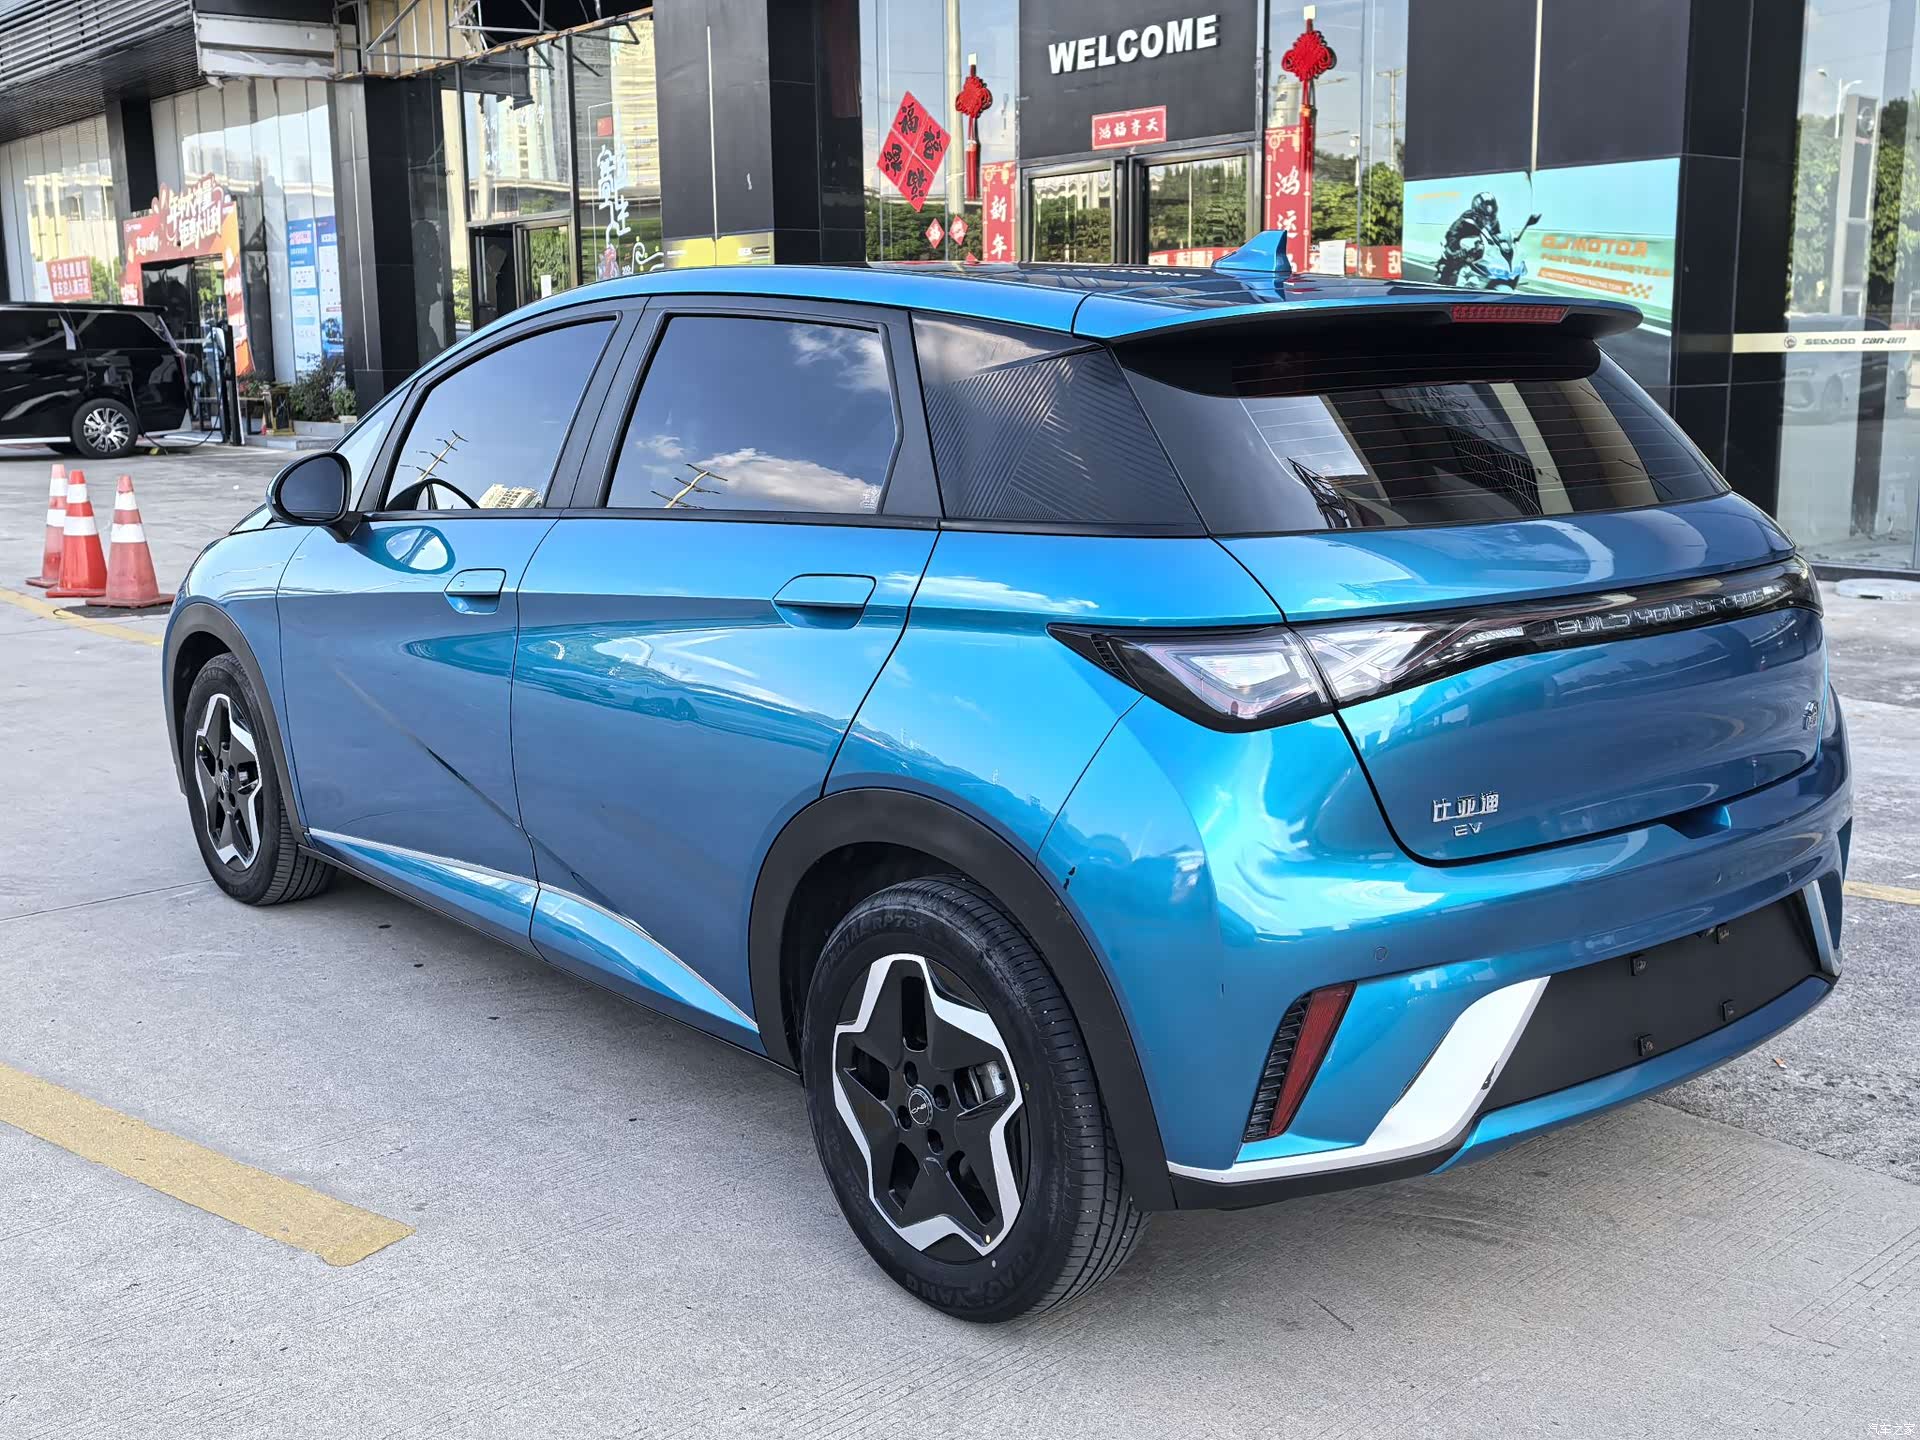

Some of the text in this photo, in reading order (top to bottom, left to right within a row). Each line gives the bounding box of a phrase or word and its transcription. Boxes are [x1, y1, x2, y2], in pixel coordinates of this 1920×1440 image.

[1049, 14, 1217, 75] WELCOME
[898, 103, 920, 135] 福
[1098, 117, 1159, 140] 鸿福齐天
[990, 195, 1008, 259] 新年
[1433, 790, 1499, 823] 比亚迪
[1453, 821, 1483, 837] EV
